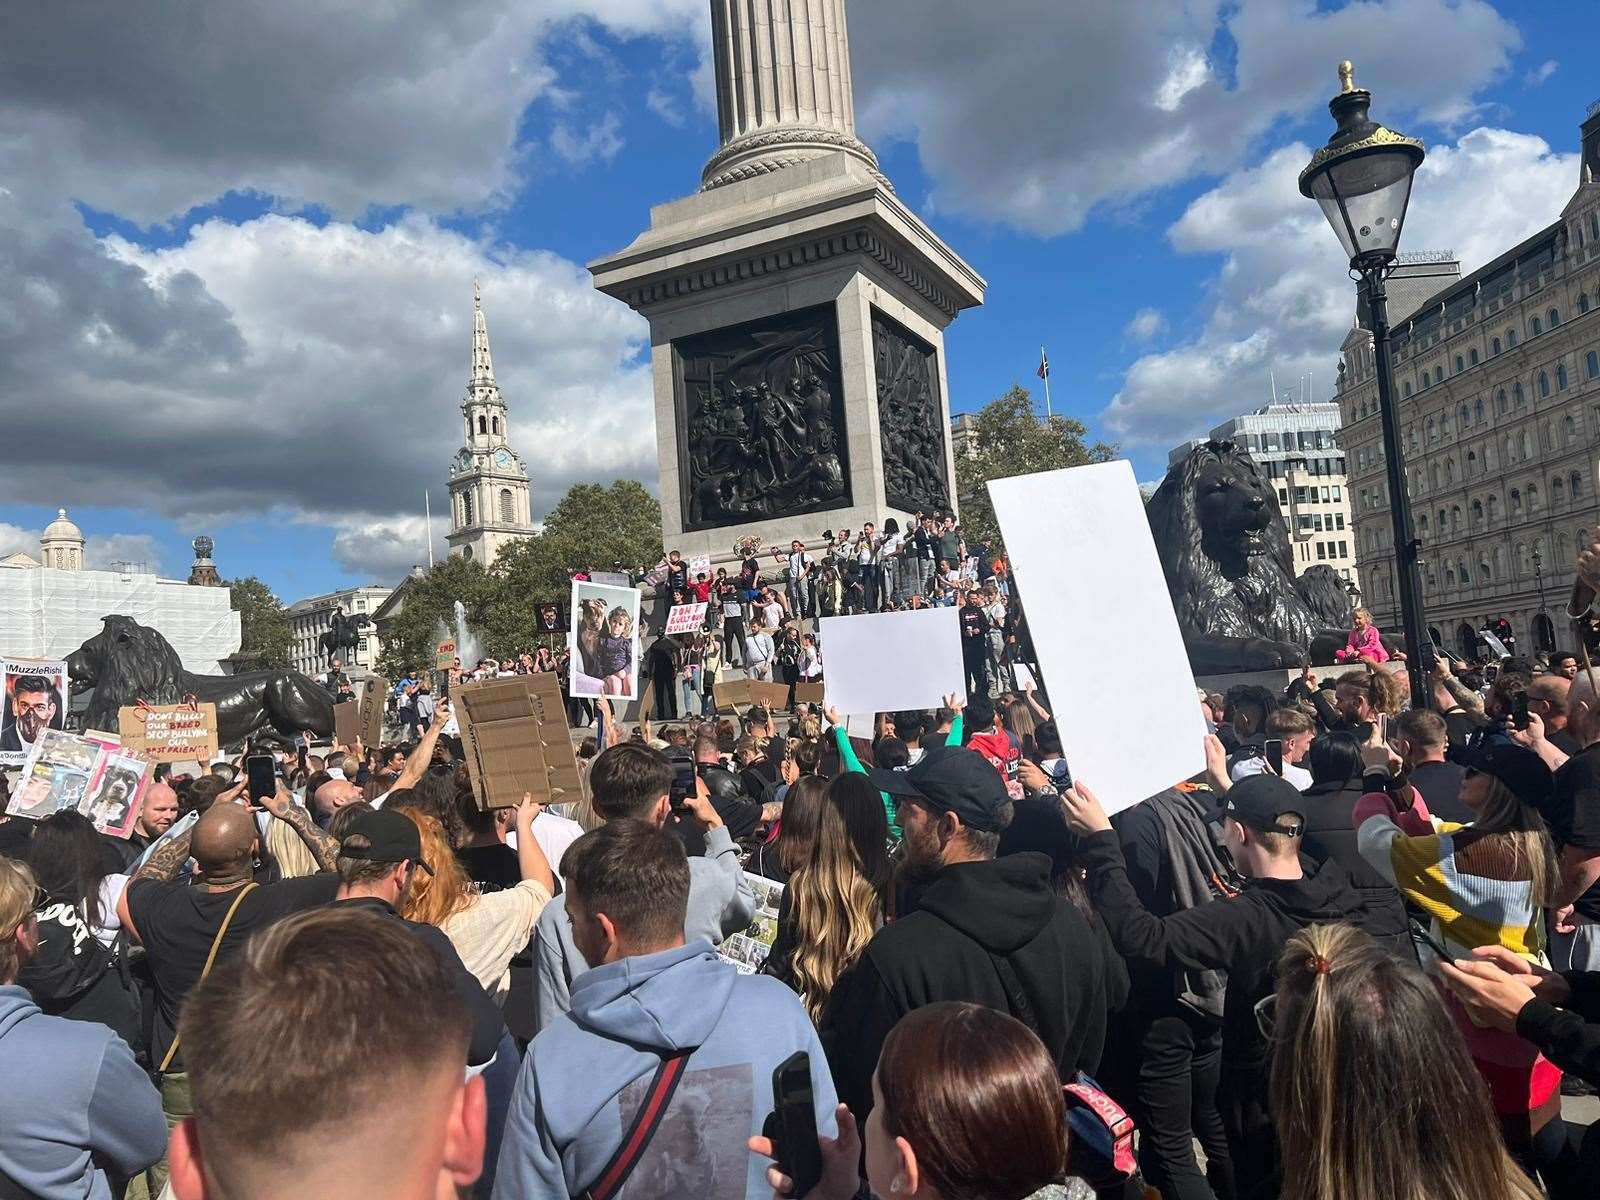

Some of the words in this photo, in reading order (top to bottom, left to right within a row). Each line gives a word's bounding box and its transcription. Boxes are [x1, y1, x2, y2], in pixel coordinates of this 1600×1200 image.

[439, 644, 455, 653] END
[175, 712, 205, 721] BULLY
[169, 721, 200, 730] BREED
[146, 731, 170, 739] STOP
